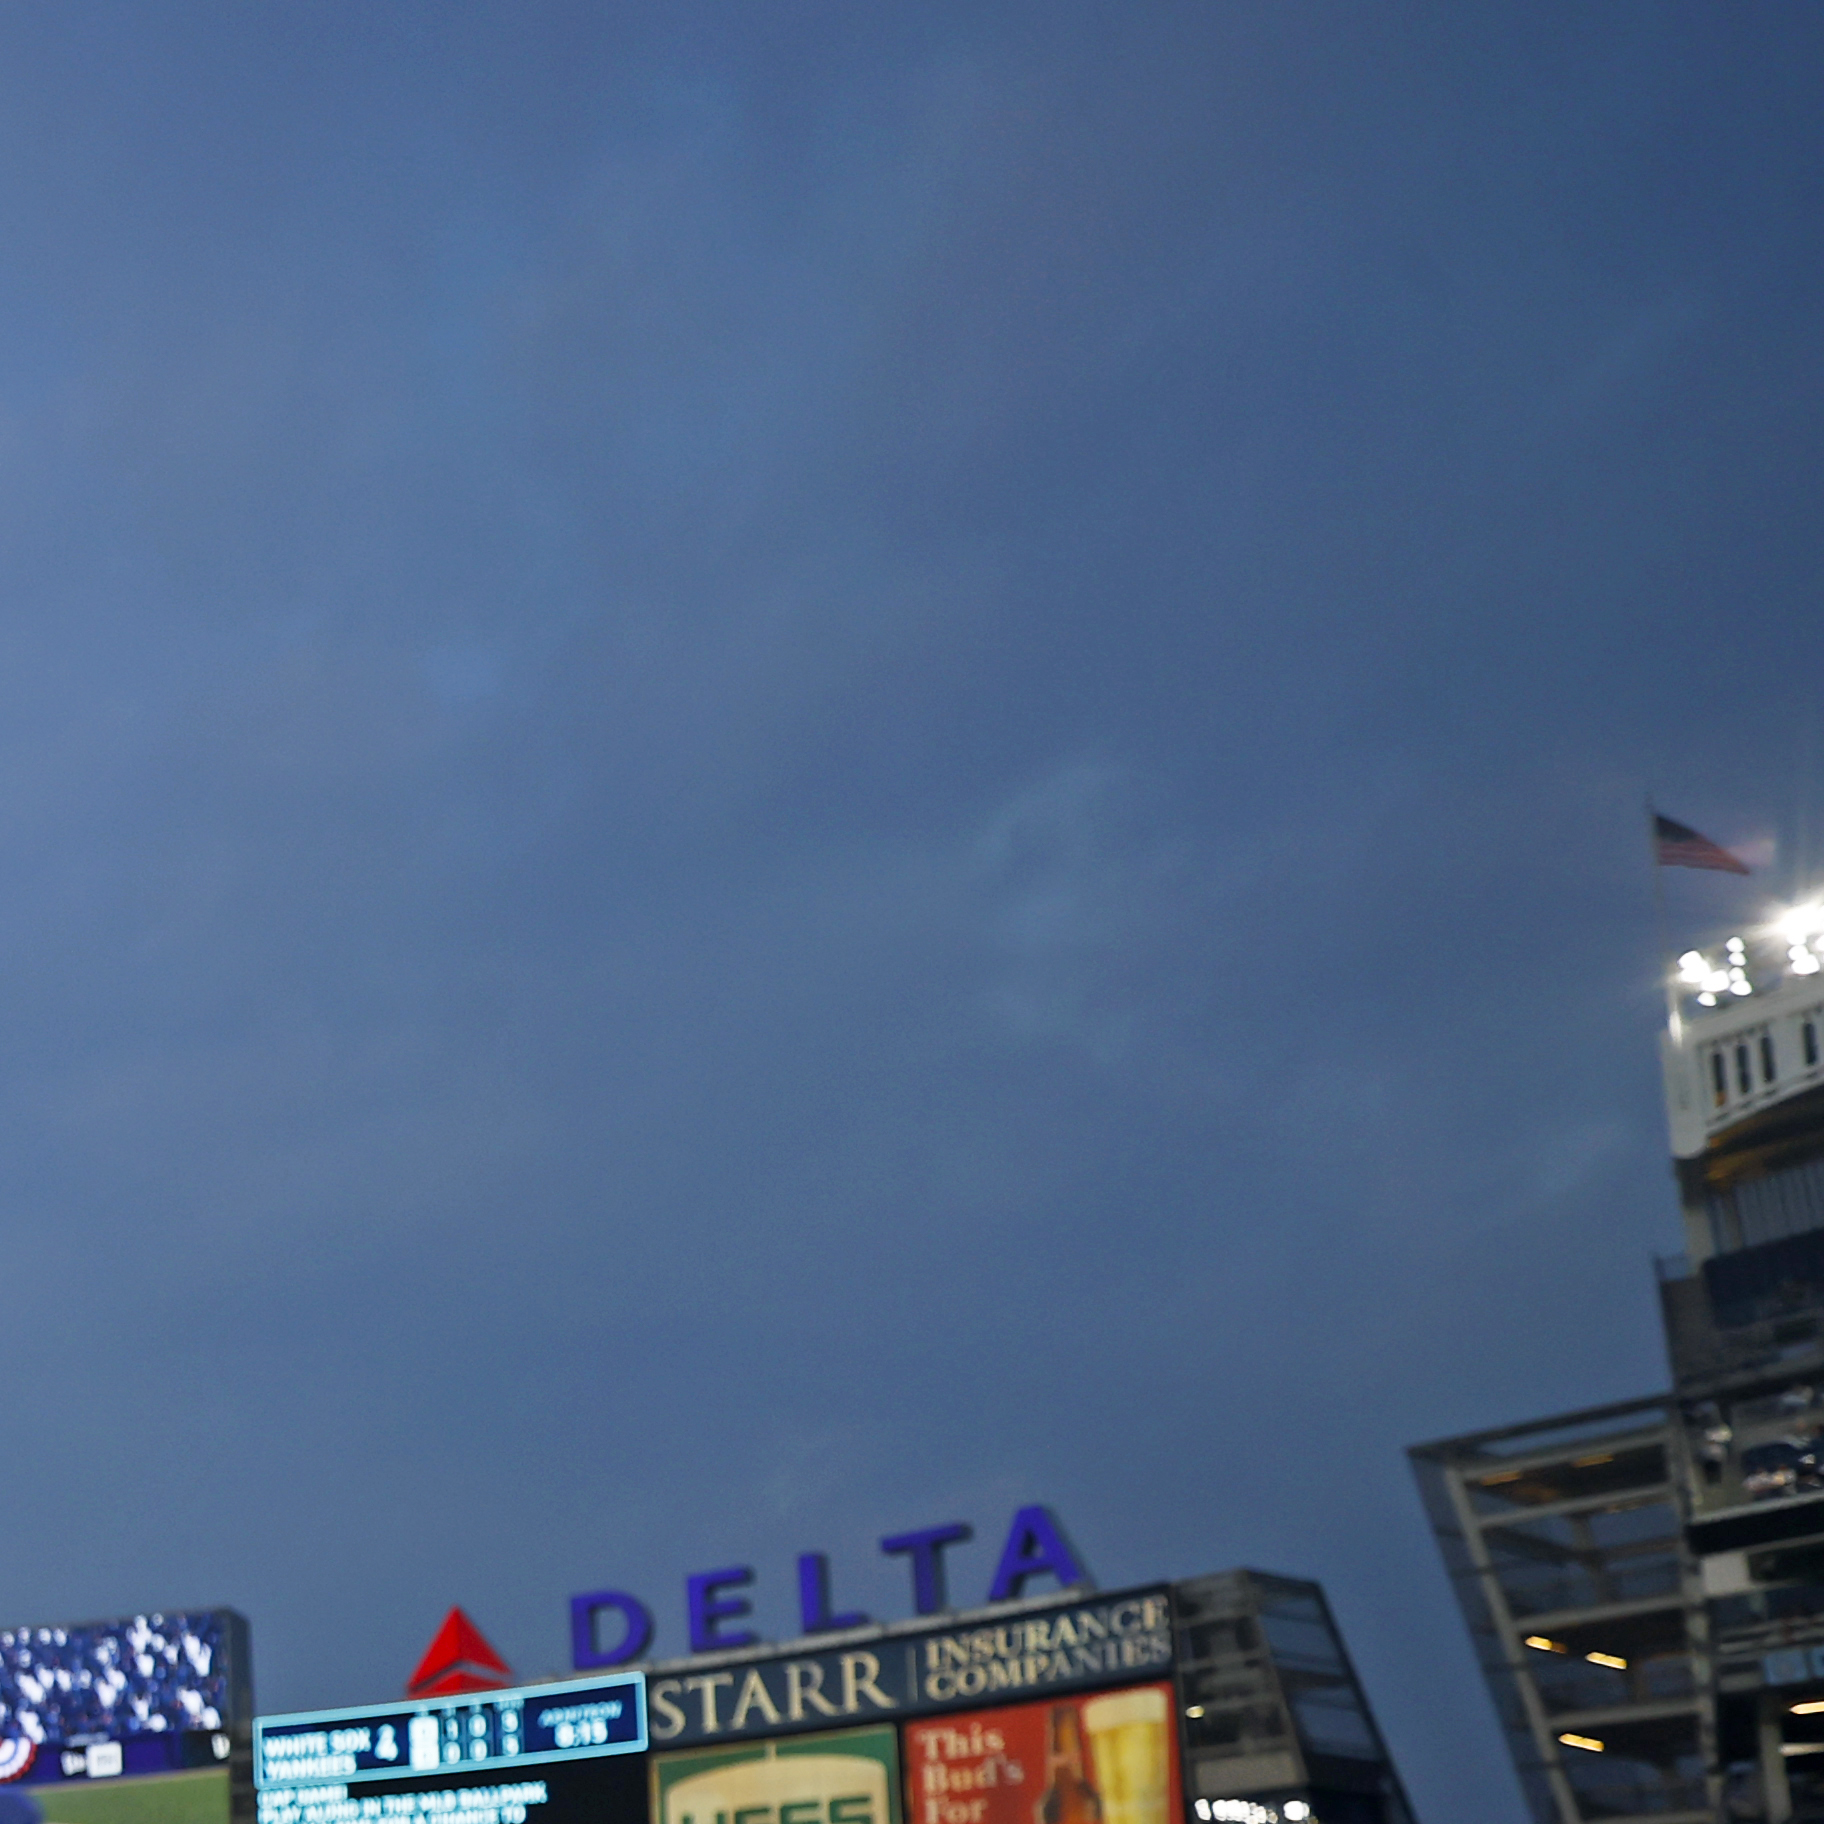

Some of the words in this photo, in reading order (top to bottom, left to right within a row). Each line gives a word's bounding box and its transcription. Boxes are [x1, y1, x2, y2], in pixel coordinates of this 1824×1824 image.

[569, 1504, 1092, 1671] DELTA
[924, 1594, 1170, 1670] INSURANCE
[924, 1629, 1171, 1702] COMPANIES
[651, 1650, 901, 1741] STARR
[263, 1731, 328, 1760] WHITE
[329, 1727, 371, 1755] SOX
[263, 1754, 356, 1781] YANKEES
[915, 1722, 1006, 1760] This
[922, 1753, 1025, 1794] Bud's
